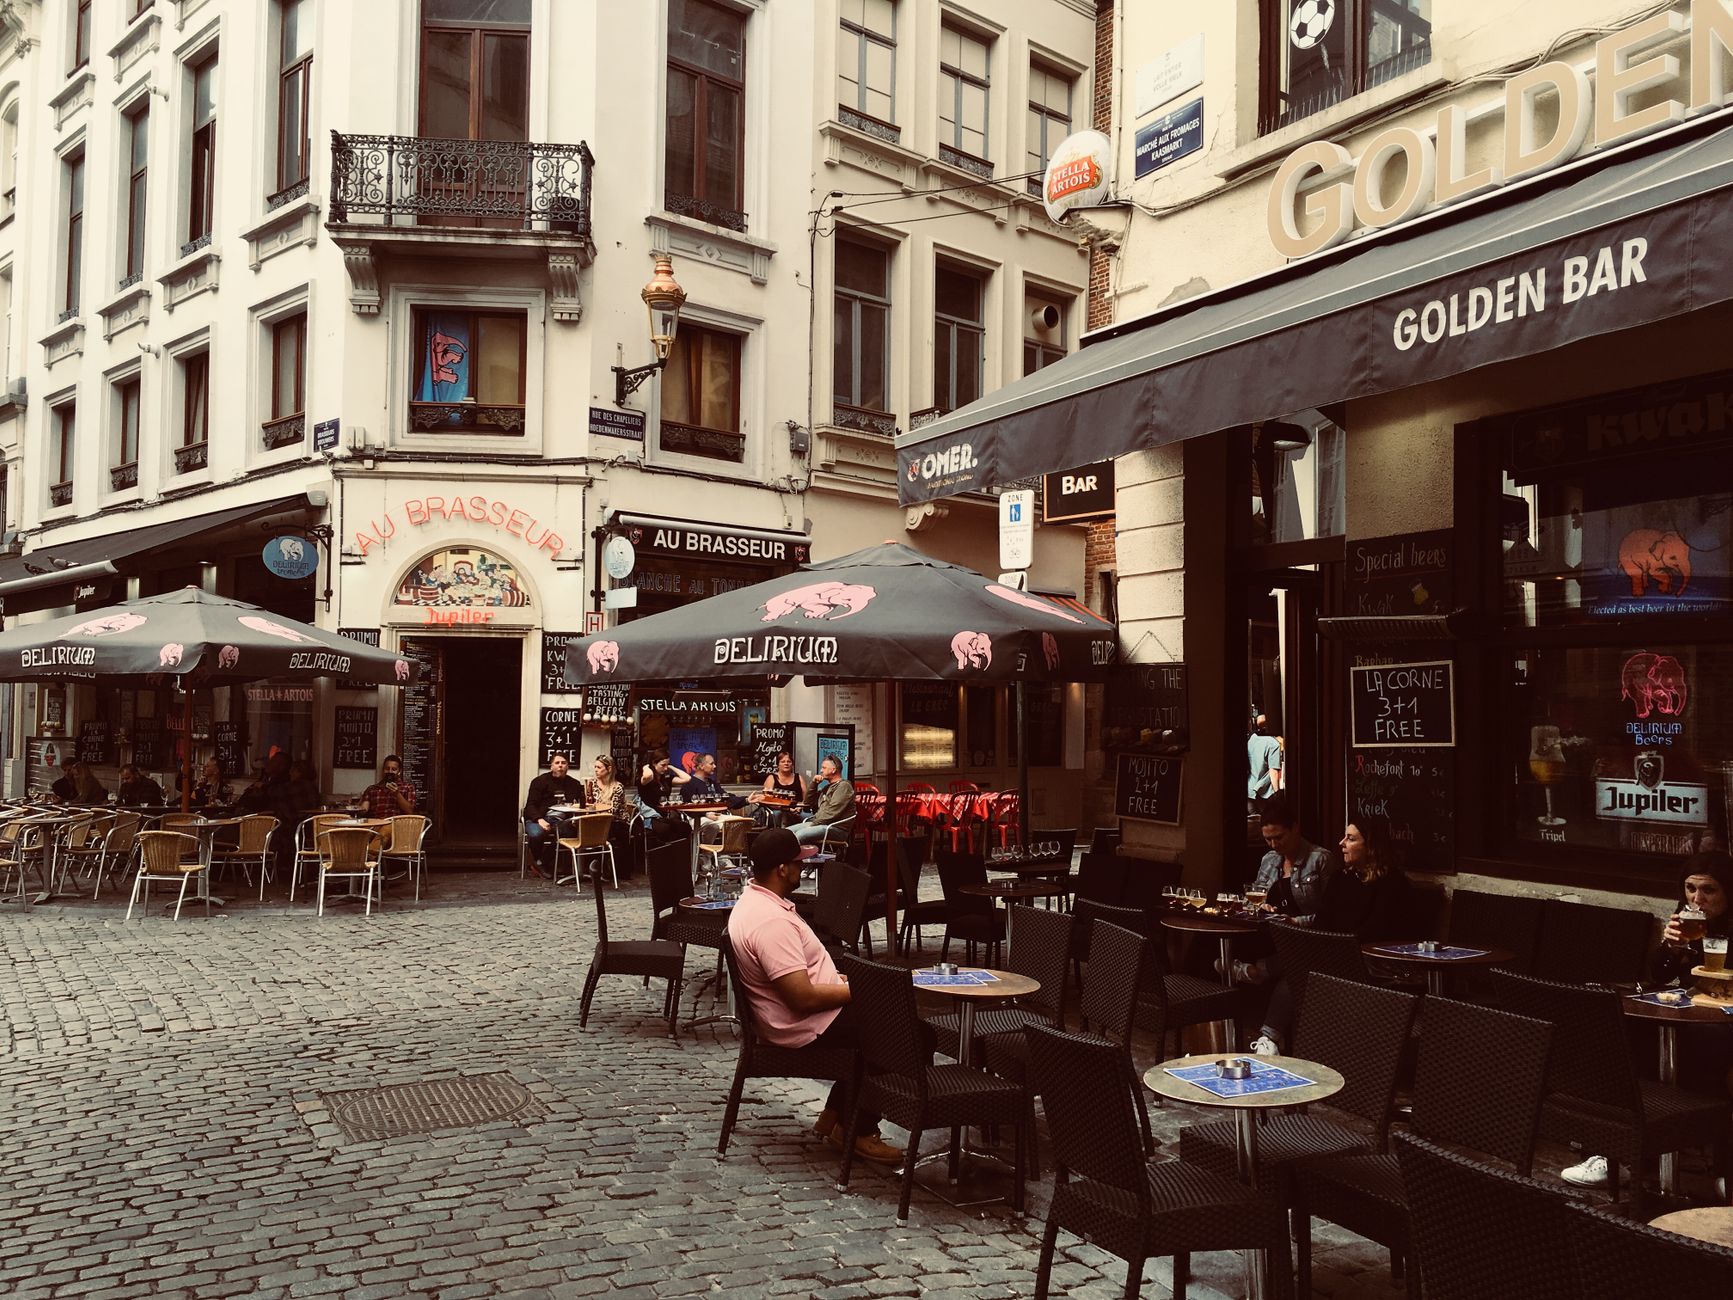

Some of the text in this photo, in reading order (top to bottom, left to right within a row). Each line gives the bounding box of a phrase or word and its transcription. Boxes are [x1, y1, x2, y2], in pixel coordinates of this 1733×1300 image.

[1136, 117, 1200, 157] MARCHÉ AUX FROMAGES
[1151, 137, 1184, 161] KAASMARKT
[1052, 161, 1090, 182] STELLA
[1051, 171, 1091, 195] ARTOIS
[1393, 237, 1648, 352] GOLDEN BAR
[591, 410, 642, 426] RUE DES CHAPELIERS
[589, 424, 643, 440] HOEDENMAKERSSTRAAT
[1061, 475, 1098, 496] BAR
[1007, 493, 1024, 503] ZONE
[356, 496, 564, 561] AU BRASSEUR
[653, 529, 786, 561] AU BRASSEUR
[272, 560, 309, 570] DELIRIUM
[1354, 542, 1405, 584] Special
[77, 584, 96, 599] Jupiler
[688, 579, 704, 595] AU
[422, 608, 495, 627] Jupiler
[1628, 604, 1645, 614] best
[1646, 603, 1664, 614] beer
[1666, 603, 1675, 612] in
[1677, 603, 1691, 612] the
[20, 646, 97, 668] DELIRIUM
[714, 636, 839, 664] DELIRIUM
[288, 652, 352, 673] DELIRIUM
[1162, 668, 1183, 690] THE
[1365, 669, 1444, 697] LA CORNE
[248, 688, 314, 702] STELLA ARTOIS
[587, 697, 626, 707] BELGIAN
[592, 689, 625, 699] TASTING
[640, 698, 737, 713] STELLA ARTOIS
[1377, 696, 1418, 718] 3+1
[545, 711, 578, 723] CORNE
[755, 728, 785, 739] PROMO
[1375, 719, 1425, 741] FREE
[1626, 722, 1683, 736] DELIRIUM
[545, 732, 573, 748] 3+1
[1634, 734, 1673, 746] Beers
[337, 749, 372, 764] FREE
[1128, 758, 1170, 778] MOJITO
[1355, 754, 1405, 779] Rochefort
[1135, 777, 1159, 796] 2+1
[1128, 795, 1158, 815] FREE
[1602, 786, 1699, 816] Jupiler
[1538, 828, 1566, 843] Tripel
